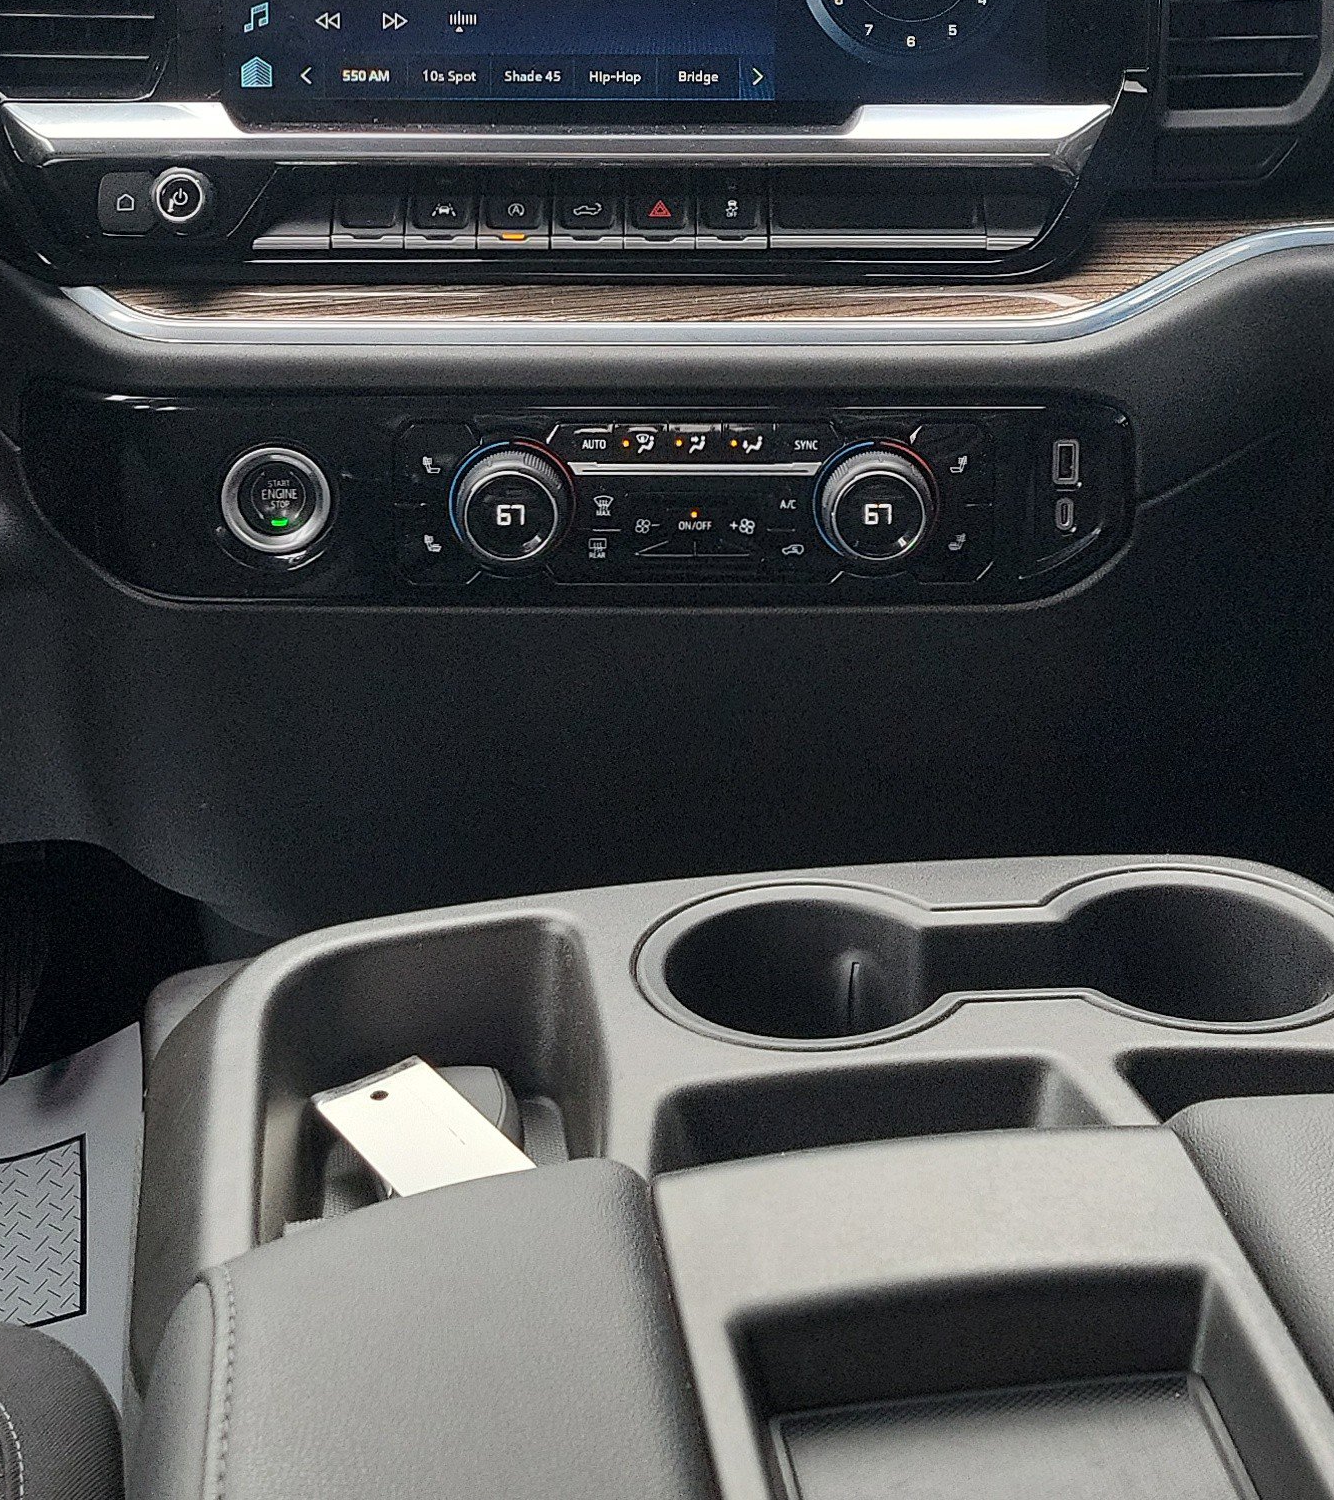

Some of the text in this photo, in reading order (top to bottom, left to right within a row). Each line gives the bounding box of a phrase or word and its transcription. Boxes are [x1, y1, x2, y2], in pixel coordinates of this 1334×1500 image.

[864, 24, 873, 37] 7
[948, 24, 958, 37] 5
[906, 35, 916, 48] 6
[342, 69, 390, 84] 550 AM
[422, 69, 477, 86] 10s Spot
[504, 69, 562, 84] Shade 45
[589, 70, 642, 86] Hip-Hop
[678, 69, 719, 87] Bridge
[582, 439, 606, 450] AUTO
[794, 440, 818, 451] SYNC
[267, 479, 291, 487] START
[261, 488, 299, 500] ENGINE
[270, 500, 291, 509] STOP
[779, 499, 796, 510] A/C
[496, 504, 525, 526] 67
[864, 503, 893, 525] 67
[678, 520, 712, 531] ON/OFF
[588, 550, 606, 559] REAR
